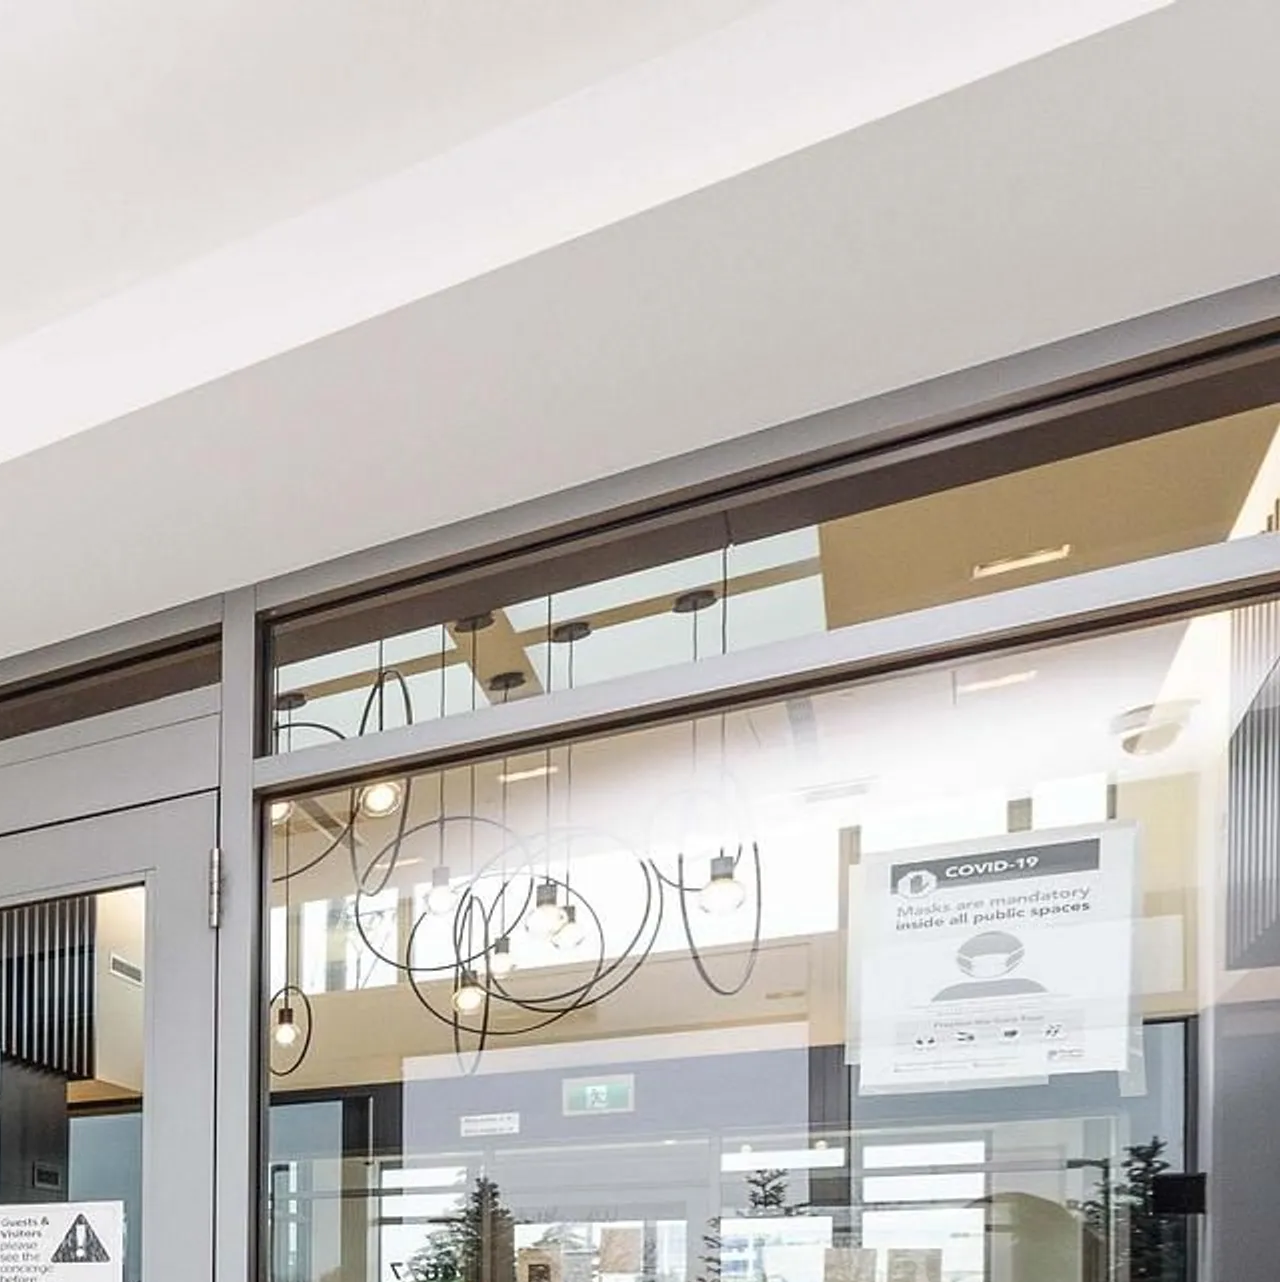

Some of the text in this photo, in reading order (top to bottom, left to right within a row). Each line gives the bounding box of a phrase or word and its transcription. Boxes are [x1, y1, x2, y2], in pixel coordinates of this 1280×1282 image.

[945, 855, 1040, 879] COVID-19
[896, 885, 1091, 918] Masks are mandatory
[896, 901, 1091, 931] inside all public spaces
[0, 1218, 38, 1227] Guests
[0, 1229, 42, 1238] Visitors
[0, 1240, 38, 1251] please
